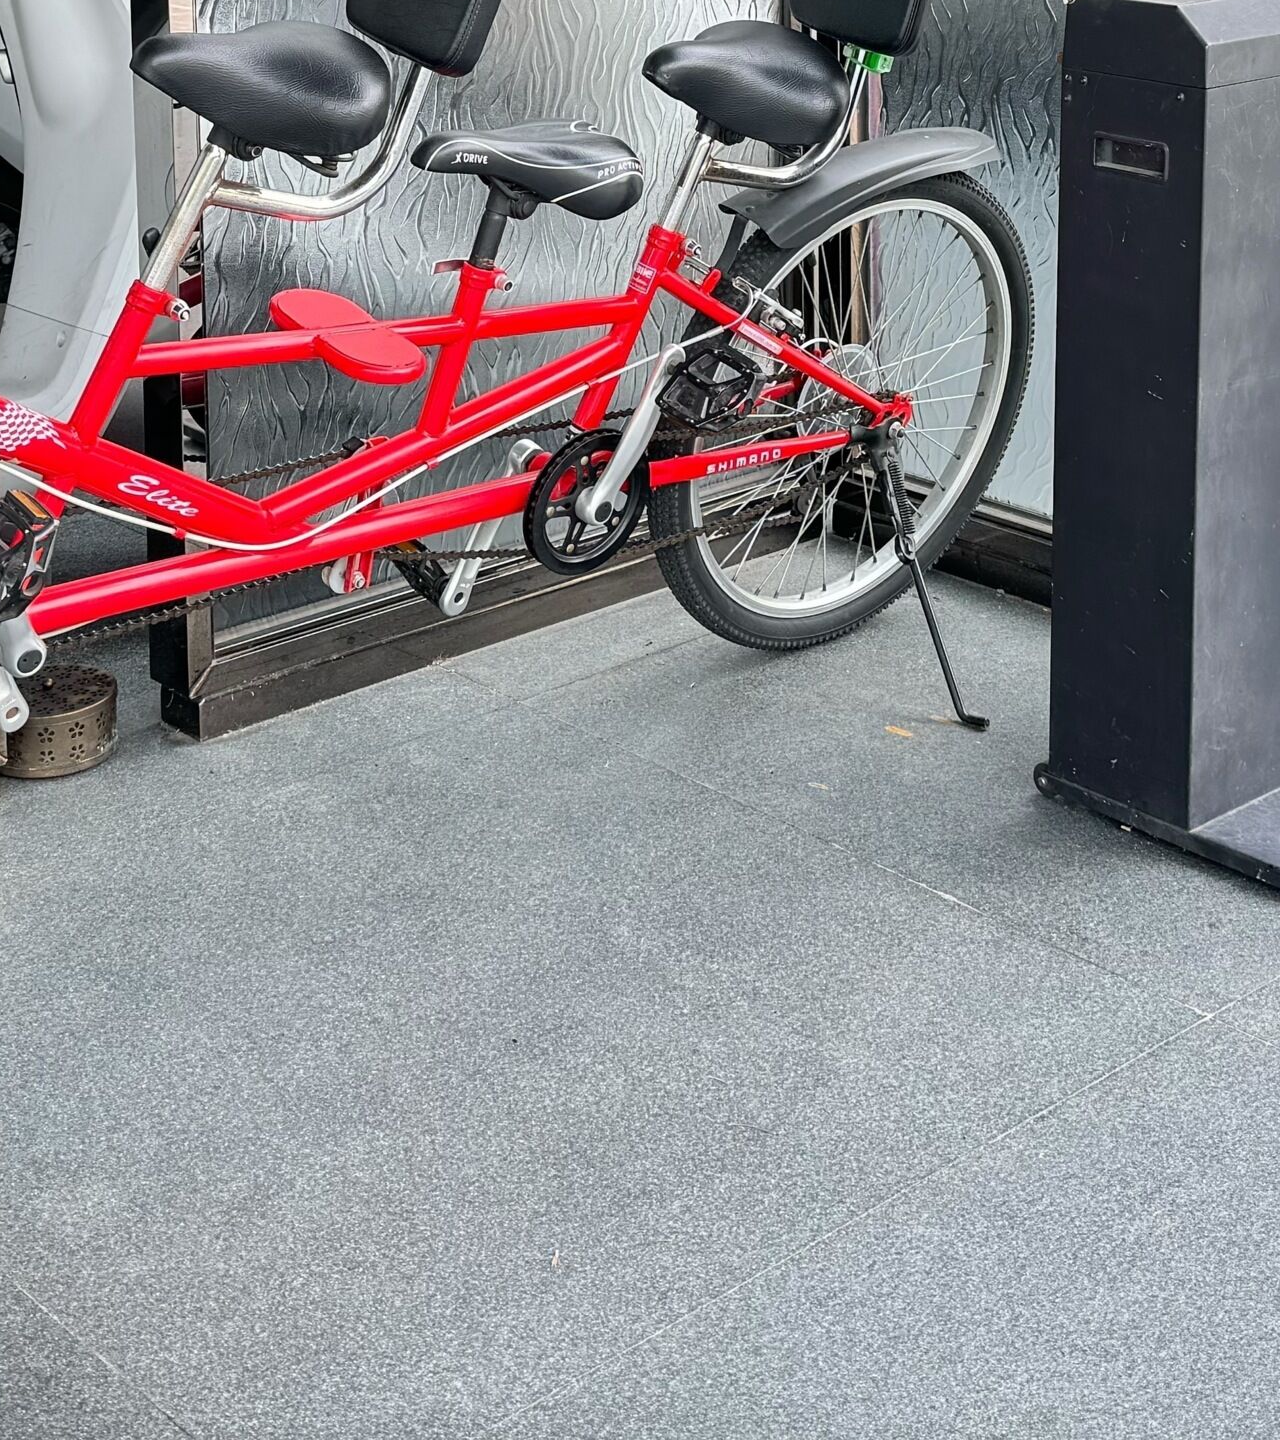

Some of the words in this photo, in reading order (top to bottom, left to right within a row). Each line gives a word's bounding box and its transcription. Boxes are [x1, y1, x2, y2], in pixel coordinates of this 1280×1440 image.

[597, 165, 616, 180] PRO
[706, 448, 781, 474] SHIMANO
[117, 474, 200, 517] Elite
